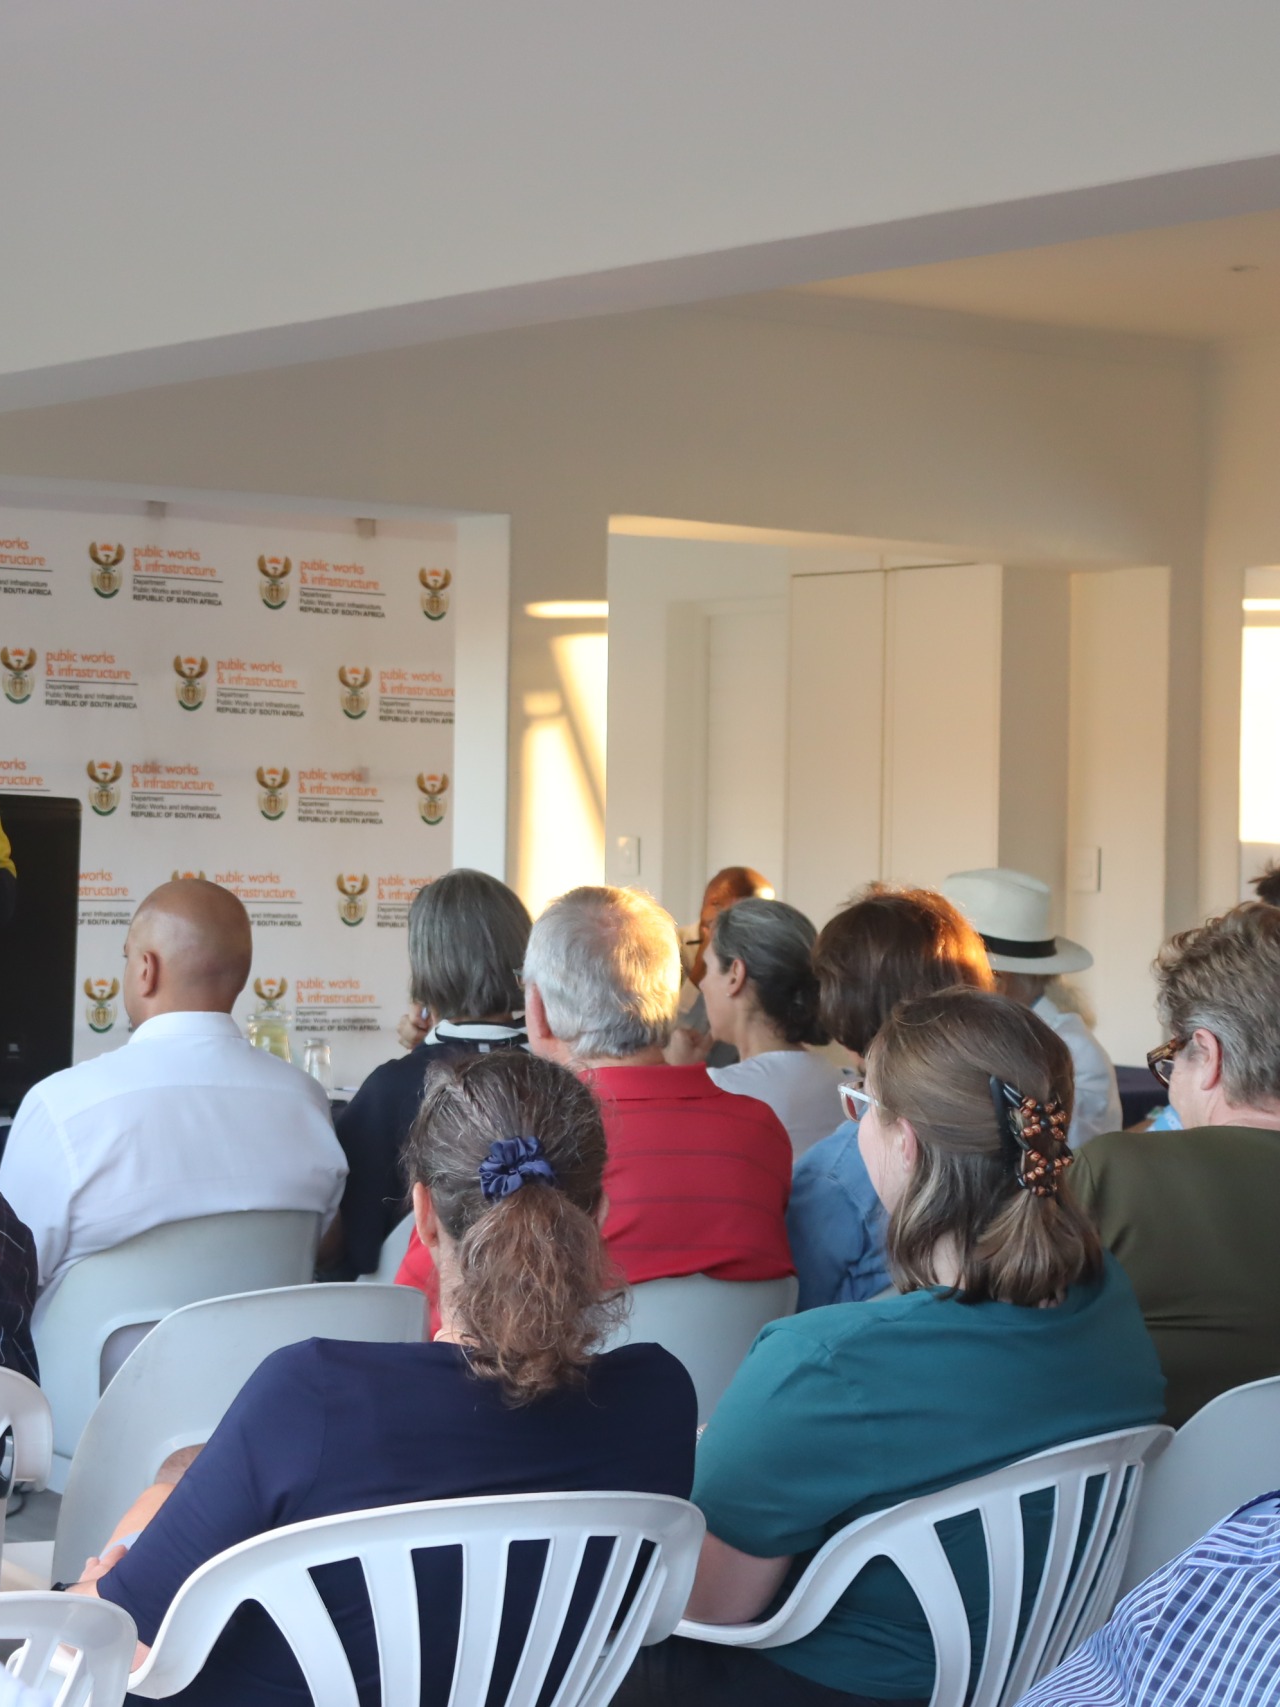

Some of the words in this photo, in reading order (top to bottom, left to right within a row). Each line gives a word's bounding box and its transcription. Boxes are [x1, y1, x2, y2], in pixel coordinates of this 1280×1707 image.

[133, 546, 164, 561] public
[168, 550, 201, 561] works
[300, 559, 329, 574] public
[332, 563, 364, 574] works
[3, 586, 26, 594] SOUTH
[46, 651, 78, 666] public
[81, 653, 115, 664] works
[58, 666, 131, 679] infrastructure
[217, 659, 247, 674] public
[250, 662, 283, 673] works
[132, 762, 163, 778] public
[166, 765, 200, 776] works
[78, 869, 112, 881] works
[215, 870, 244, 883] public
[249, 872, 281, 884] works
[409, 876, 435, 886] wor
[78, 885, 128, 896] structure
[230, 886, 296, 898] frastructure
